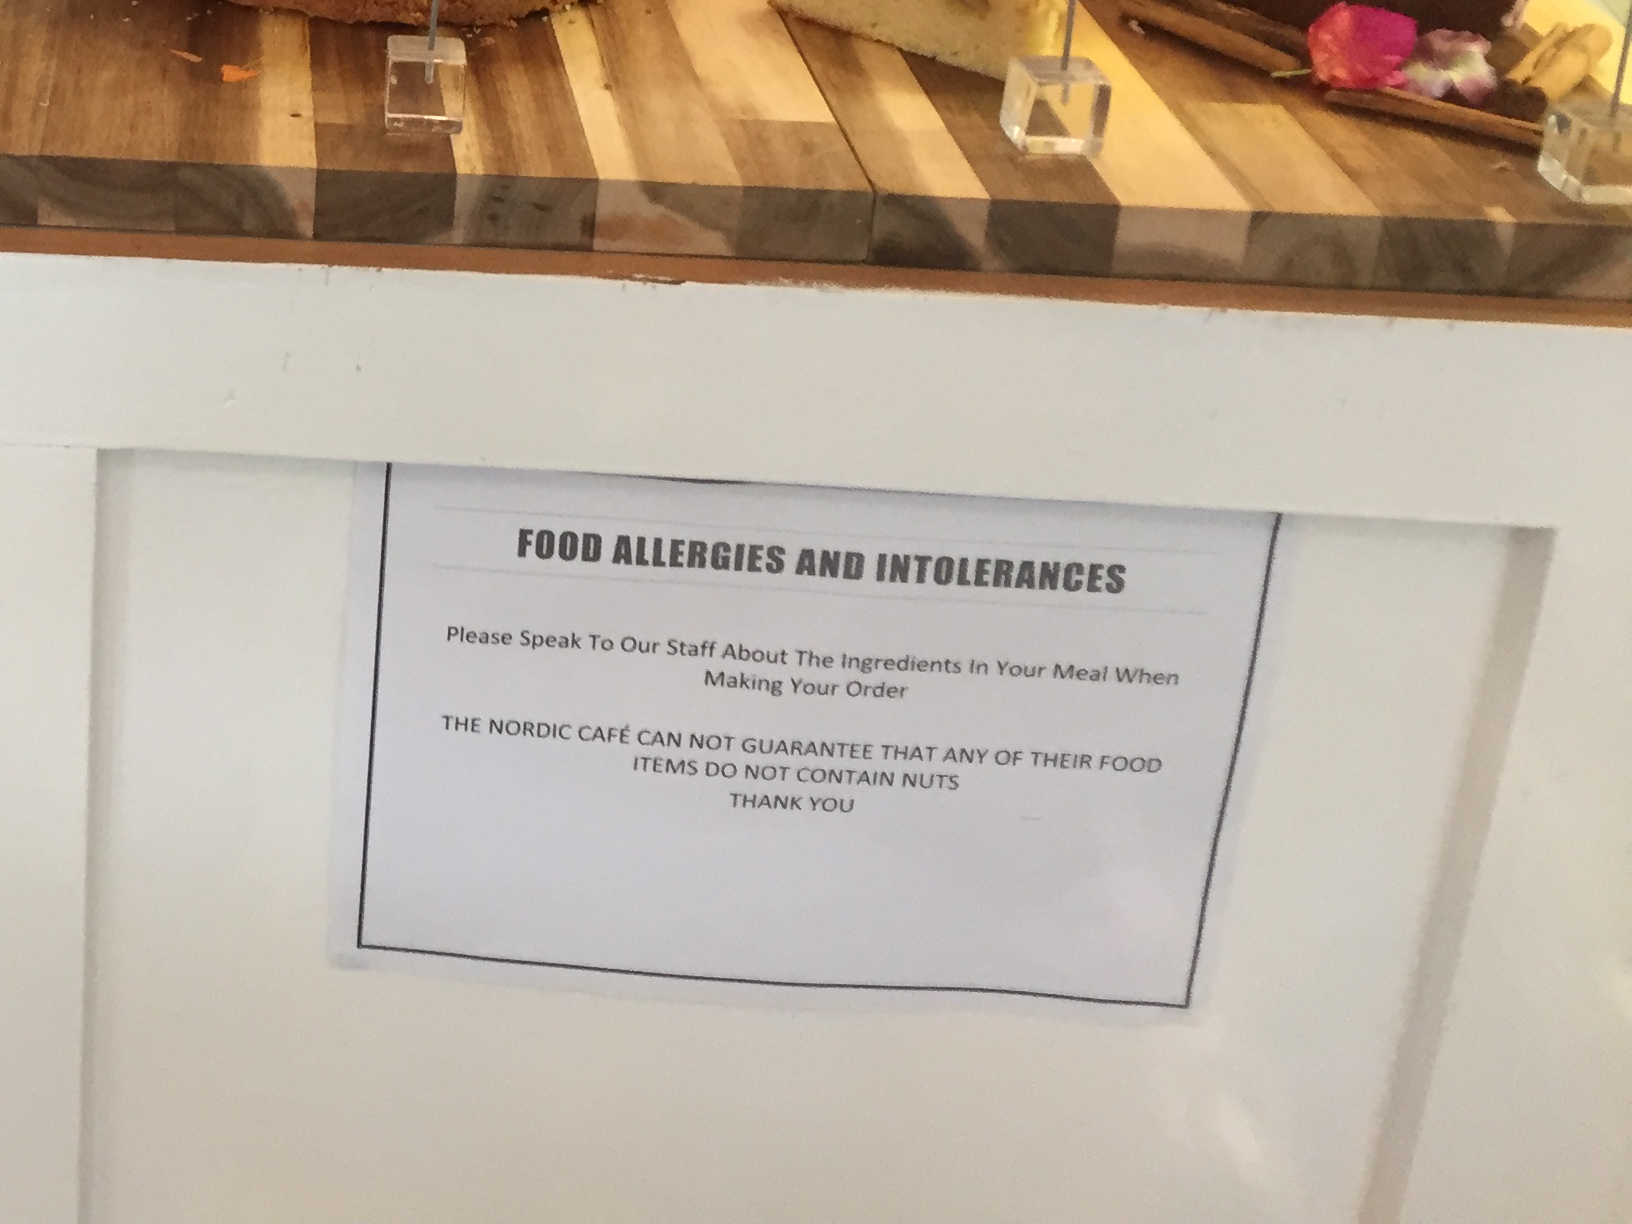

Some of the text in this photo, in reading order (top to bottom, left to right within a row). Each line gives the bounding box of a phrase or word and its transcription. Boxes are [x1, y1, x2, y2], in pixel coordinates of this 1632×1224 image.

[517, 528, 1126, 594] FOOD ALLERGIES AND INTOLERANCES
[447, 626, 1179, 685] Please Speak To Our Staff About The Ingredients In Your Meal When
[704, 670, 908, 698] Making Your Order
[442, 715, 1162, 773] THE NORDIC CAFÉ CAN NOT GUARANTEE THAT ANY OF THEIR FOOD
[633, 757, 959, 790] ITEMS DO NOT CONTAIN NUTS
[730, 793, 854, 813] THANK YOU
